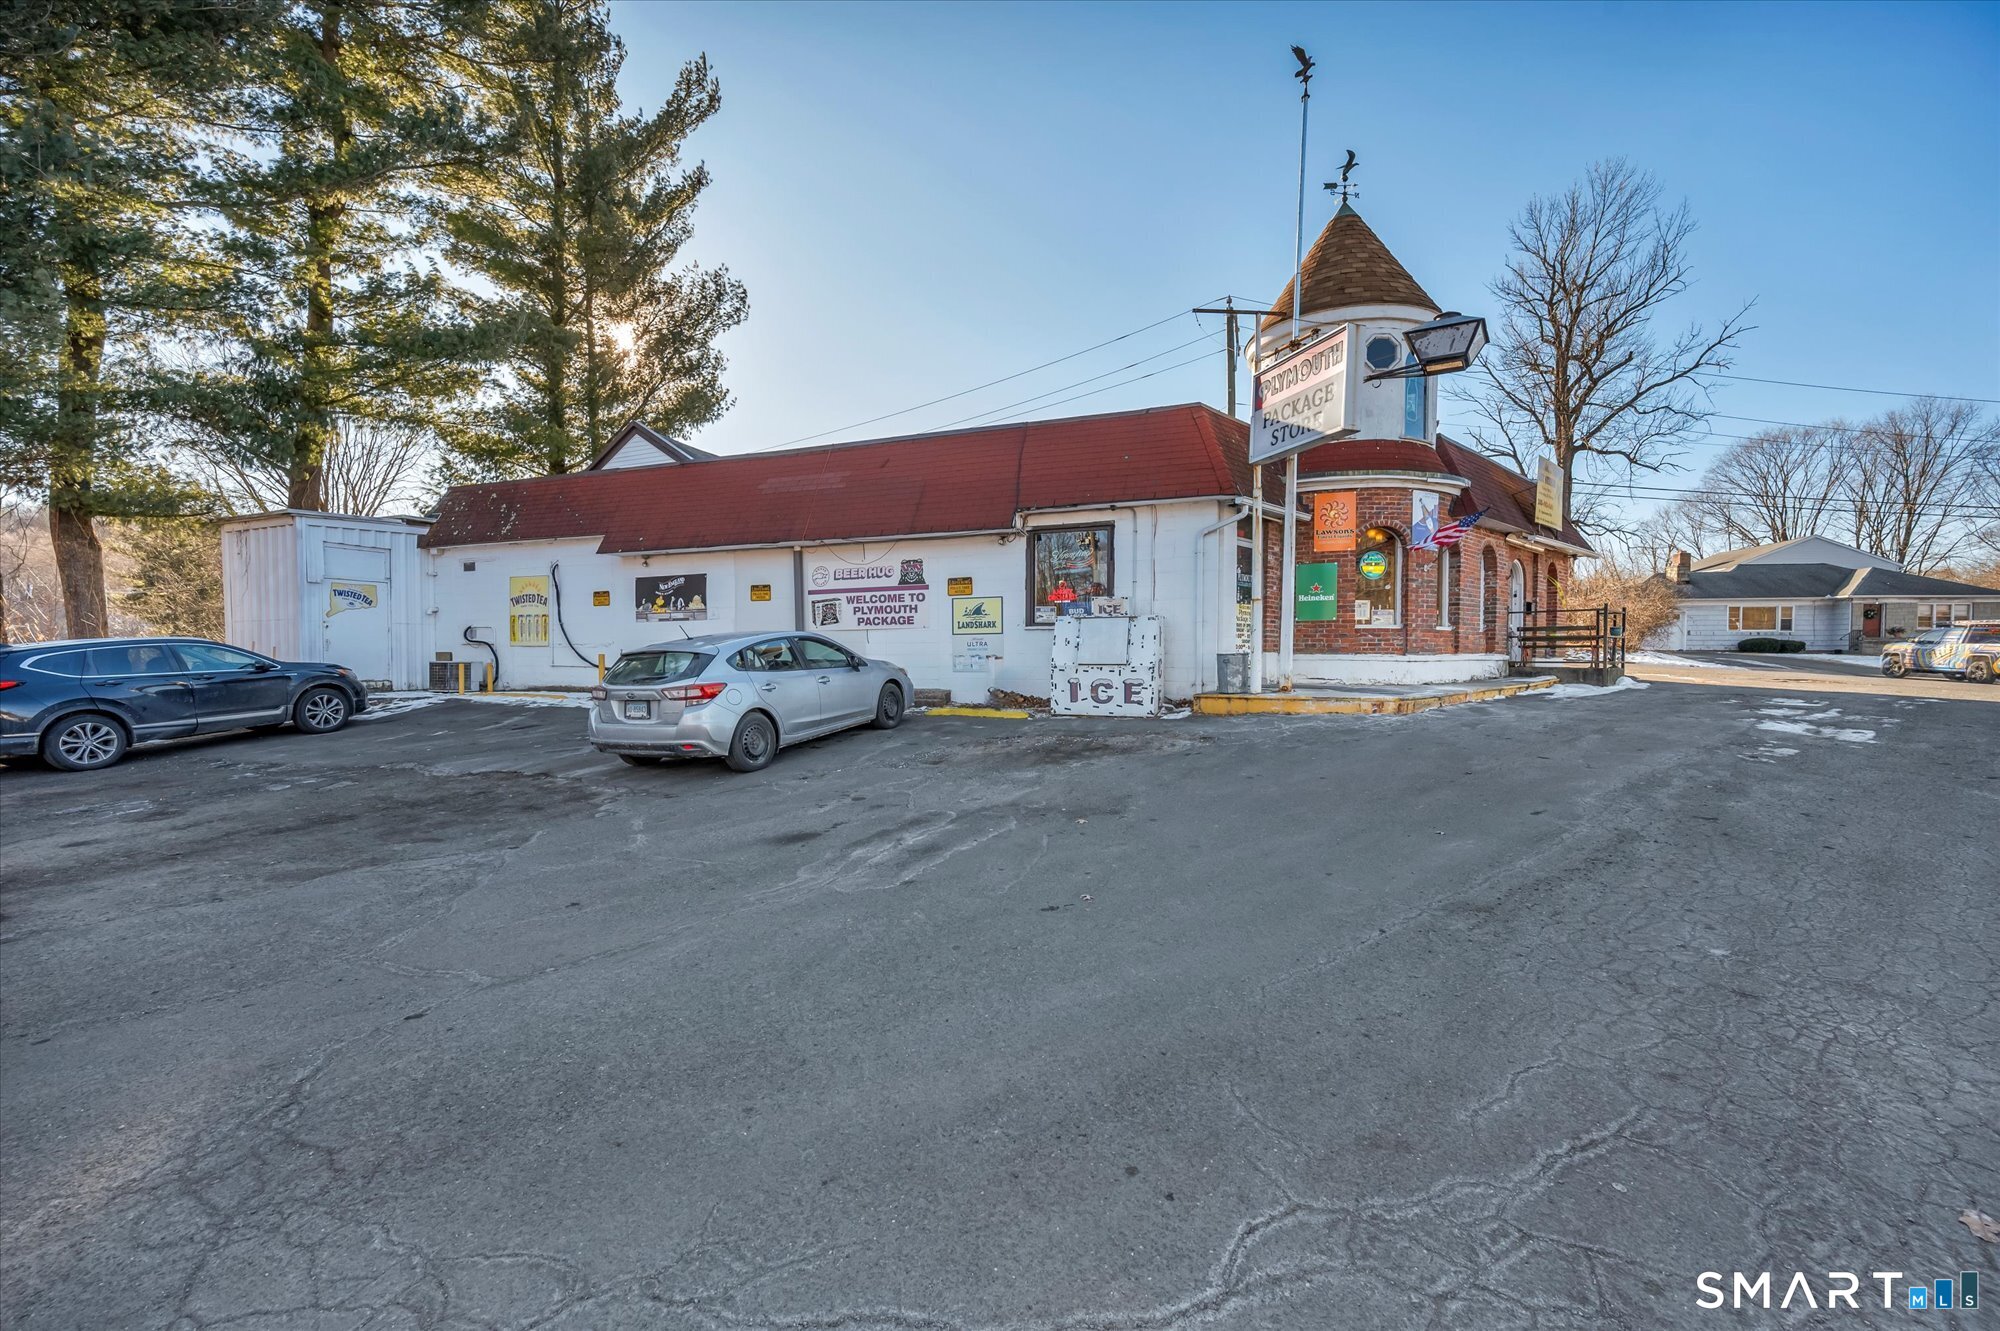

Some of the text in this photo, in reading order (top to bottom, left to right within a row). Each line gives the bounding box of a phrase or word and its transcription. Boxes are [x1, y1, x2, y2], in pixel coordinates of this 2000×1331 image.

[1259, 340, 1344, 403] PLYMOUTH
[1263, 382, 1335, 429] PACKAGE
[1270, 410, 1322, 446] STORE
[834, 567, 867, 581] BEER
[867, 566, 895, 580] HUG
[332, 588, 362, 600] TWISTED
[361, 594, 373, 606] TEA
[510, 593, 548, 607] TWISTED TEA
[846, 592, 926, 605] WELCOME TO
[1298, 593, 1335, 602] Heineken
[853, 604, 918, 615] PLYMOUTH
[1098, 604, 1121, 615] ICE
[857, 615, 915, 626] PACKAGE
[957, 620, 997, 630] LANDSHARK
[1067, 677, 1145, 705] ICE
